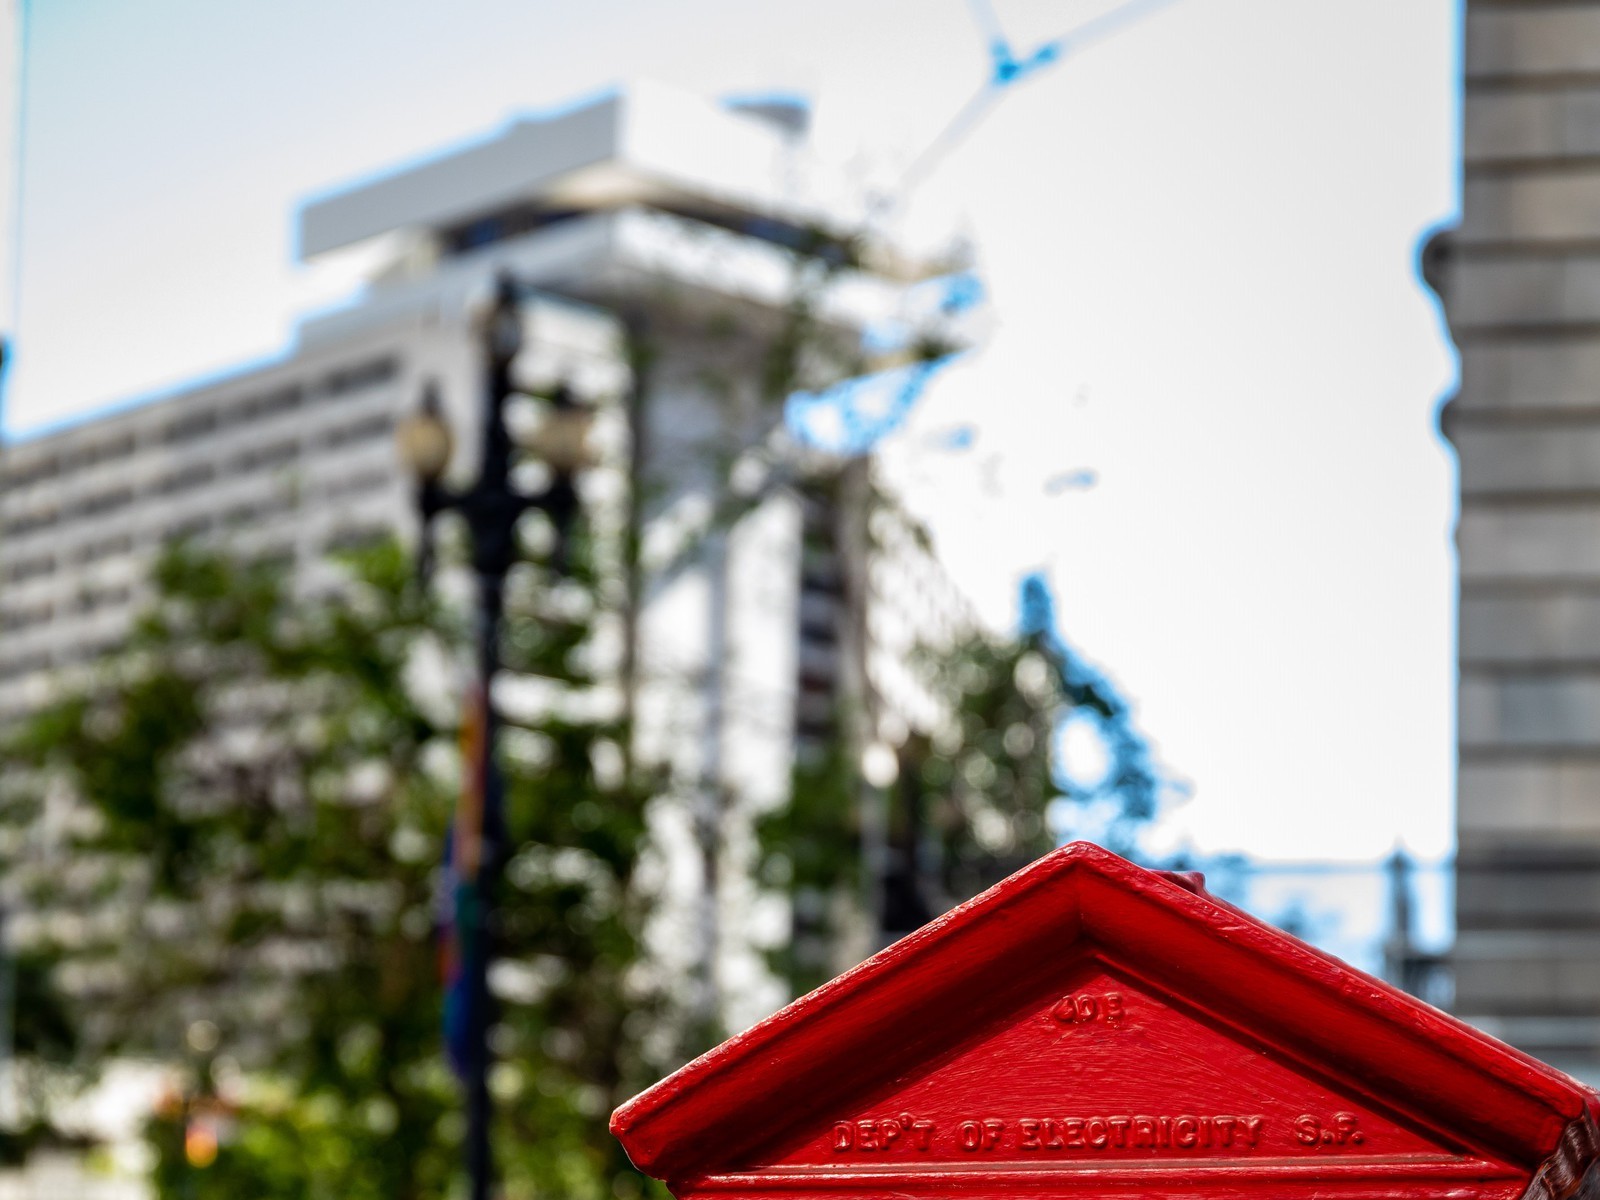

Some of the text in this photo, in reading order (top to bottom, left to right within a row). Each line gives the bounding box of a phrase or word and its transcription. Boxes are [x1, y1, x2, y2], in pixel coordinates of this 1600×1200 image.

[833, 1110, 1365, 1151] DEP'T OF ELECTRICITY S.F.
